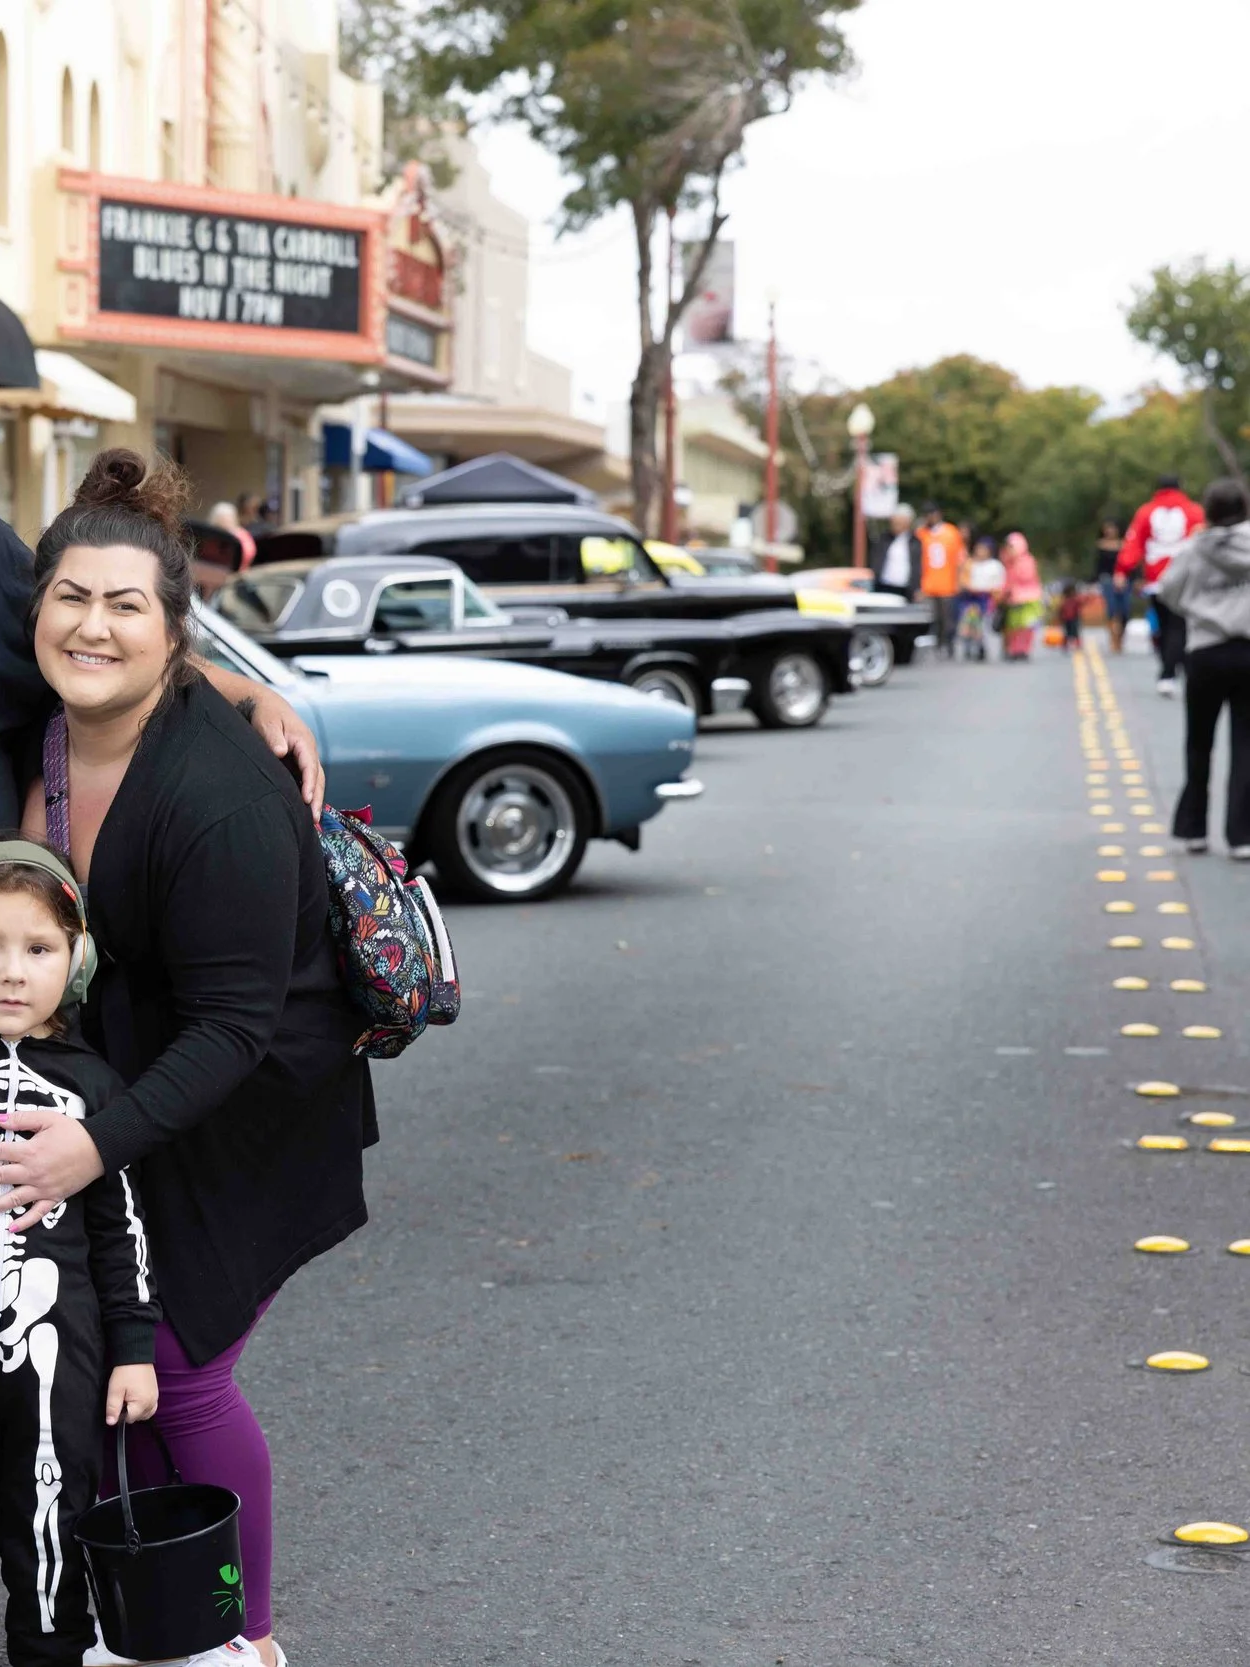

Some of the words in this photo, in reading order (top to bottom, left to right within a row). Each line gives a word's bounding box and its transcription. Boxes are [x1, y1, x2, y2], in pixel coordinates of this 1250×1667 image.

[101, 206, 192, 249] FRANKIE
[194, 217, 213, 251] G
[234, 220, 271, 258] TIA
[272, 225, 359, 268] CARROLL
[132, 245, 200, 284] BLUES
[202, 250, 229, 288] IN
[230, 256, 272, 292] THE
[273, 260, 333, 299] NIGHT
[178, 286, 223, 321] NOV
[240, 292, 285, 326] 7PM
